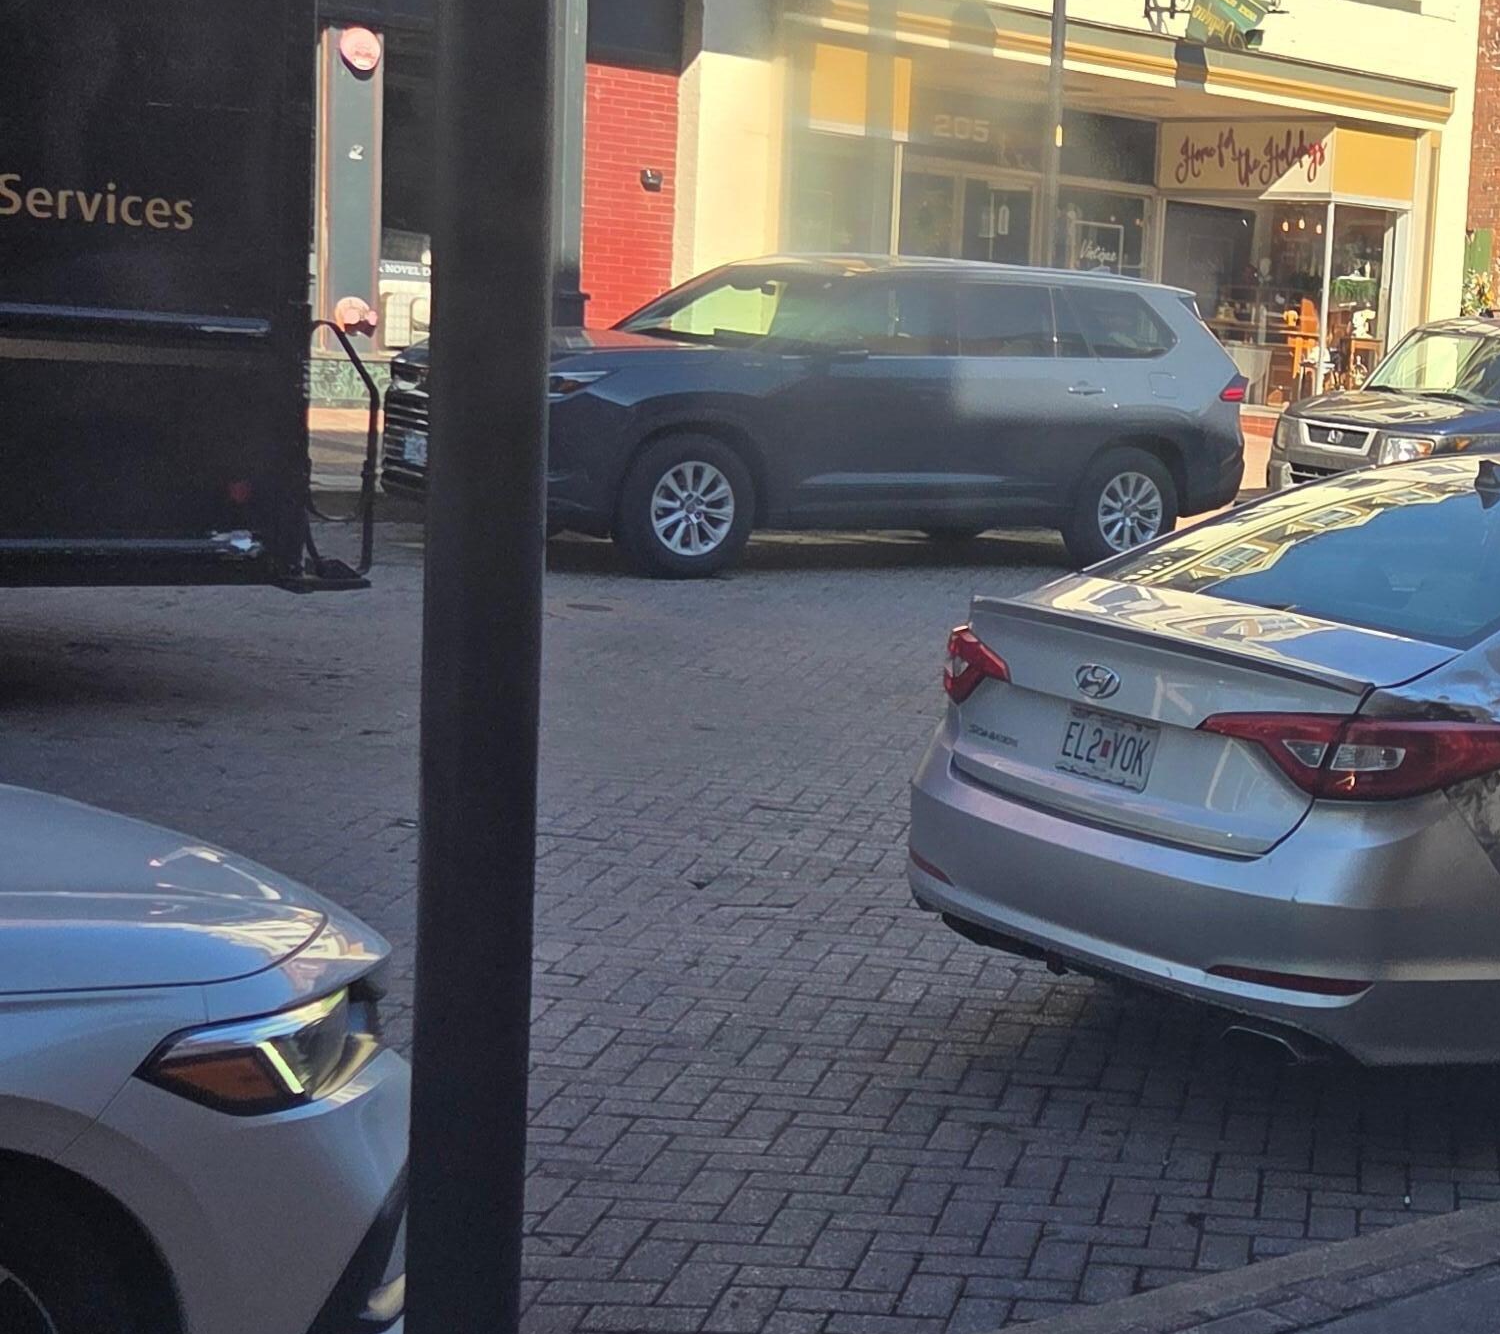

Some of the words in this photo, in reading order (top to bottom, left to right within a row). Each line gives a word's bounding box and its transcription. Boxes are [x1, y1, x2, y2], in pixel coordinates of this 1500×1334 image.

[932, 114, 990, 143] 205
[0, 172, 195, 232] Services
[384, 262, 421, 276] NOVEL
[1061, 721, 1103, 764] EL2
